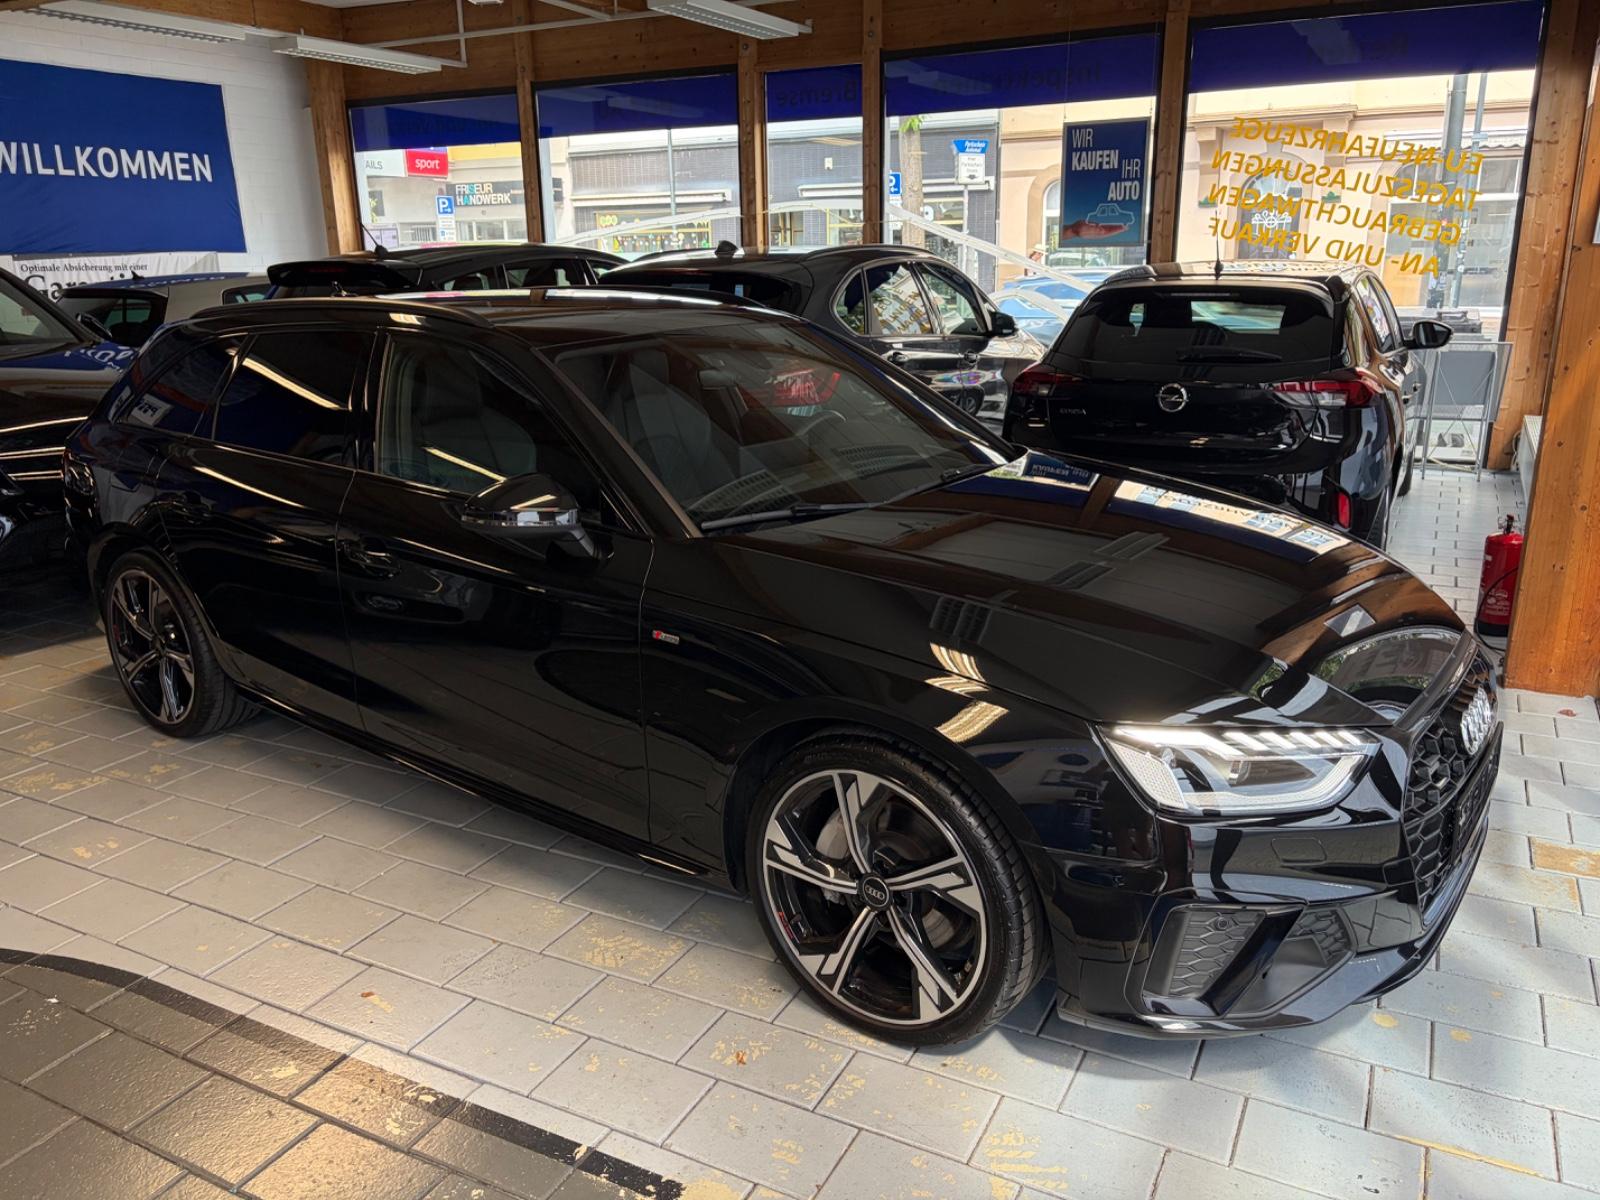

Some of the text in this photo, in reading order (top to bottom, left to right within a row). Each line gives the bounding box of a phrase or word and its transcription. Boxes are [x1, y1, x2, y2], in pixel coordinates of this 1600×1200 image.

[1072, 128, 1094, 149] WIR
[0, 141, 213, 182] WILLKOMMEN
[415, 158, 440, 171] sport
[1071, 149, 1119, 171] KAUFEN
[1121, 158, 1141, 179] IHR
[455, 183, 493, 195] FRISEUR
[1107, 181, 1140, 201] AUTO
[456, 193, 511, 206] HANDWERK
[20, 263, 60, 274] Optimale
[63, 262, 113, 273] Absicherung
[114, 262, 128, 271] mit
